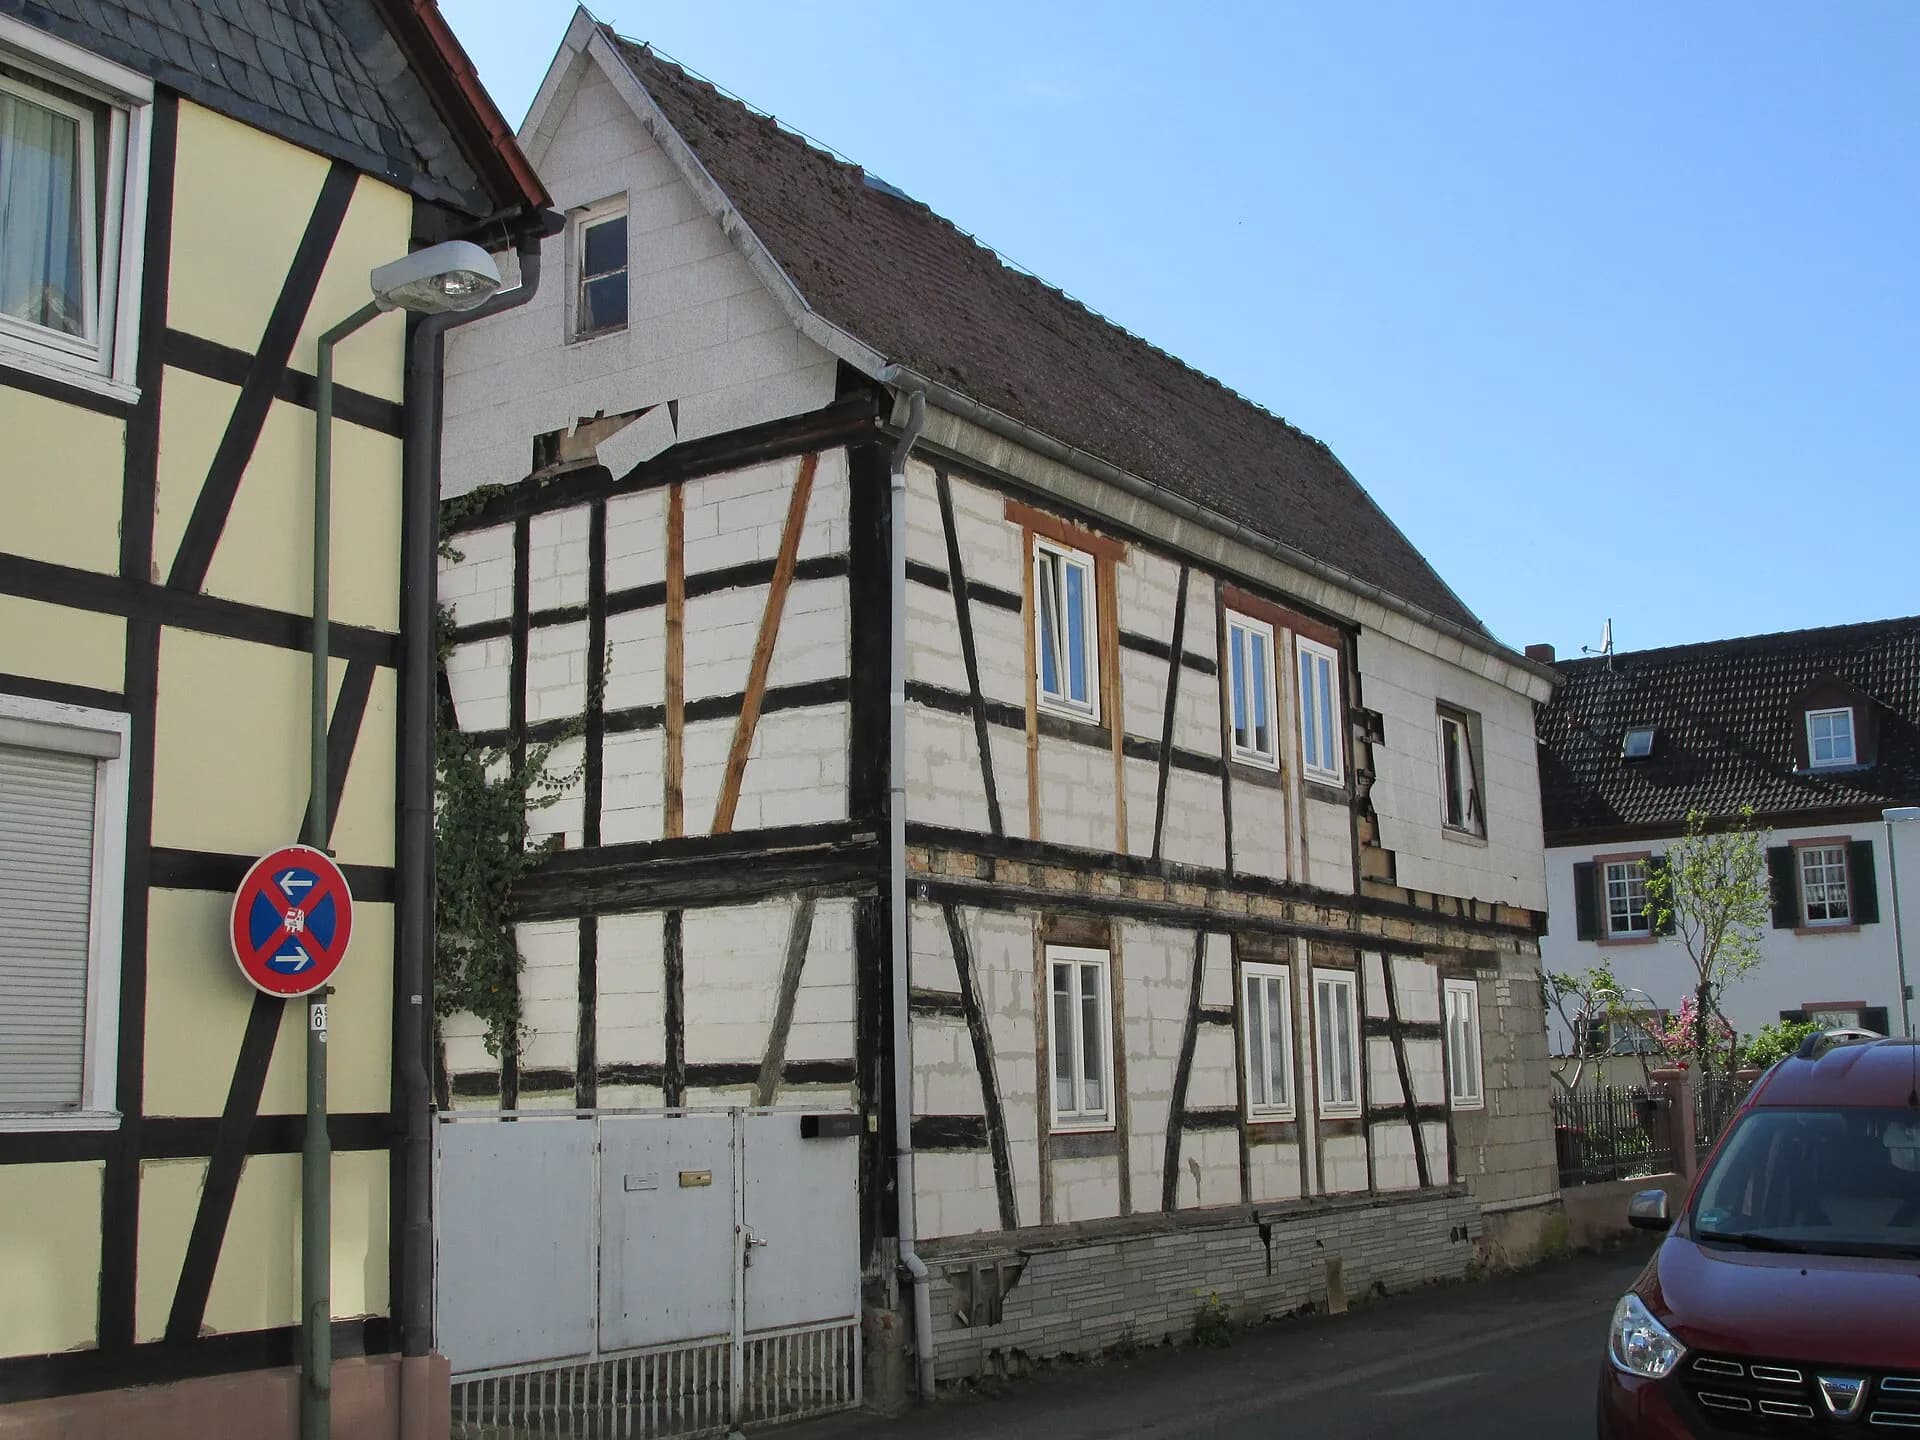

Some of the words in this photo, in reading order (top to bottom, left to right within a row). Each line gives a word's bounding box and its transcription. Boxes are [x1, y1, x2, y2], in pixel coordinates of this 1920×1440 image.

[920, 883, 927, 898] 2
[314, 1017, 328, 1028] 0
[1824, 1383, 1859, 1392] DACIA
